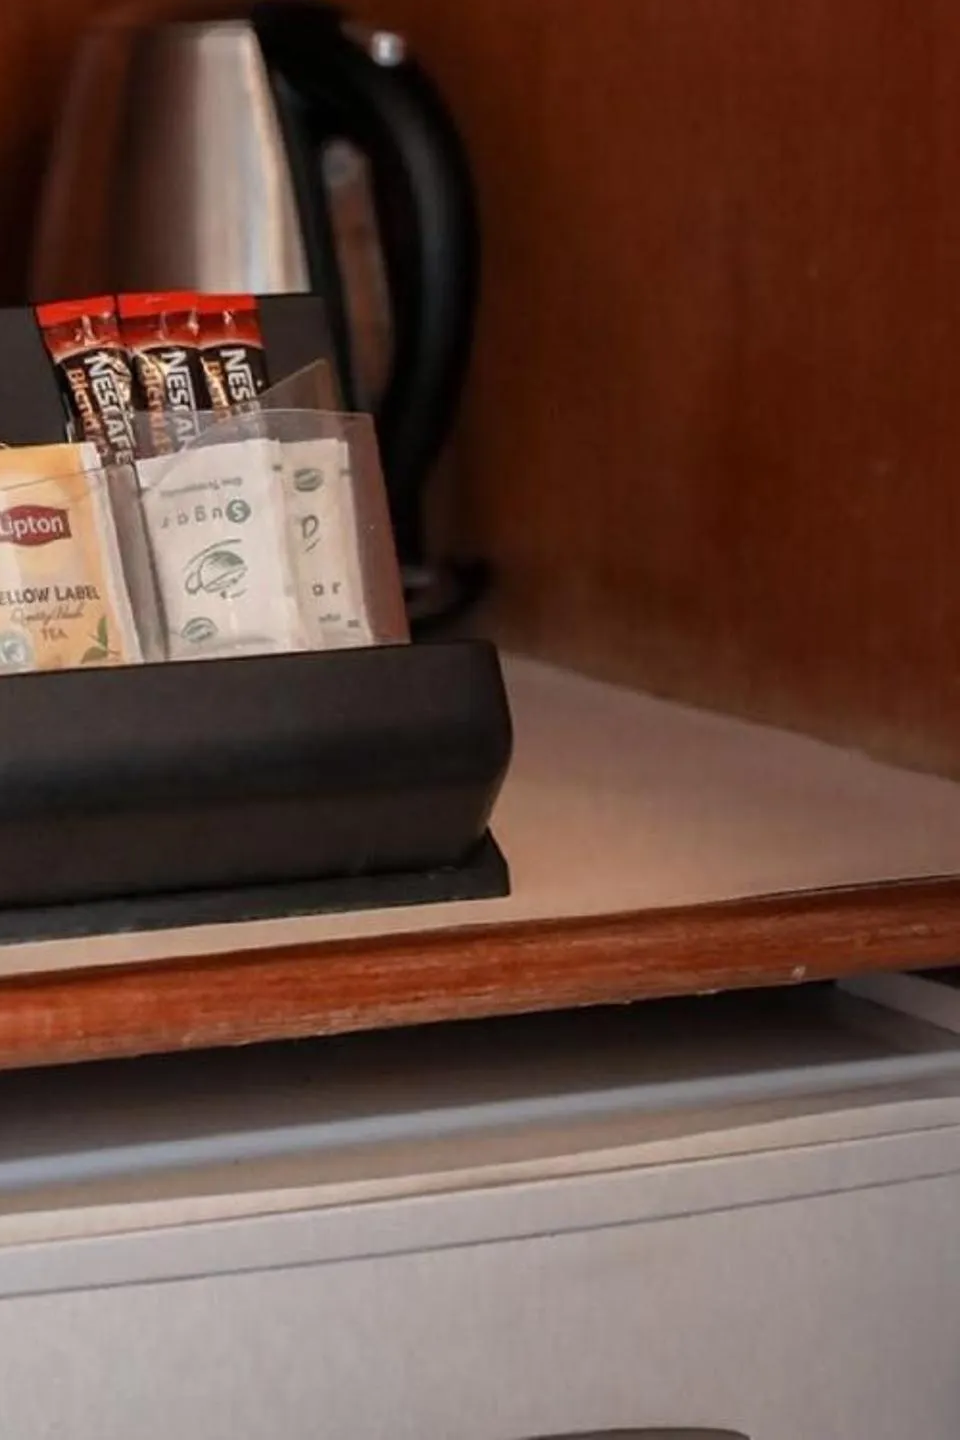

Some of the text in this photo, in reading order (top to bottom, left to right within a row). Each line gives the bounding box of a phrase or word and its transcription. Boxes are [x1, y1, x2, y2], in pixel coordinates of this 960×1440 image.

[161, 498, 252, 529] Sugar
[54, 584, 101, 602] LABEL
[40, 627, 69, 641] TEA
